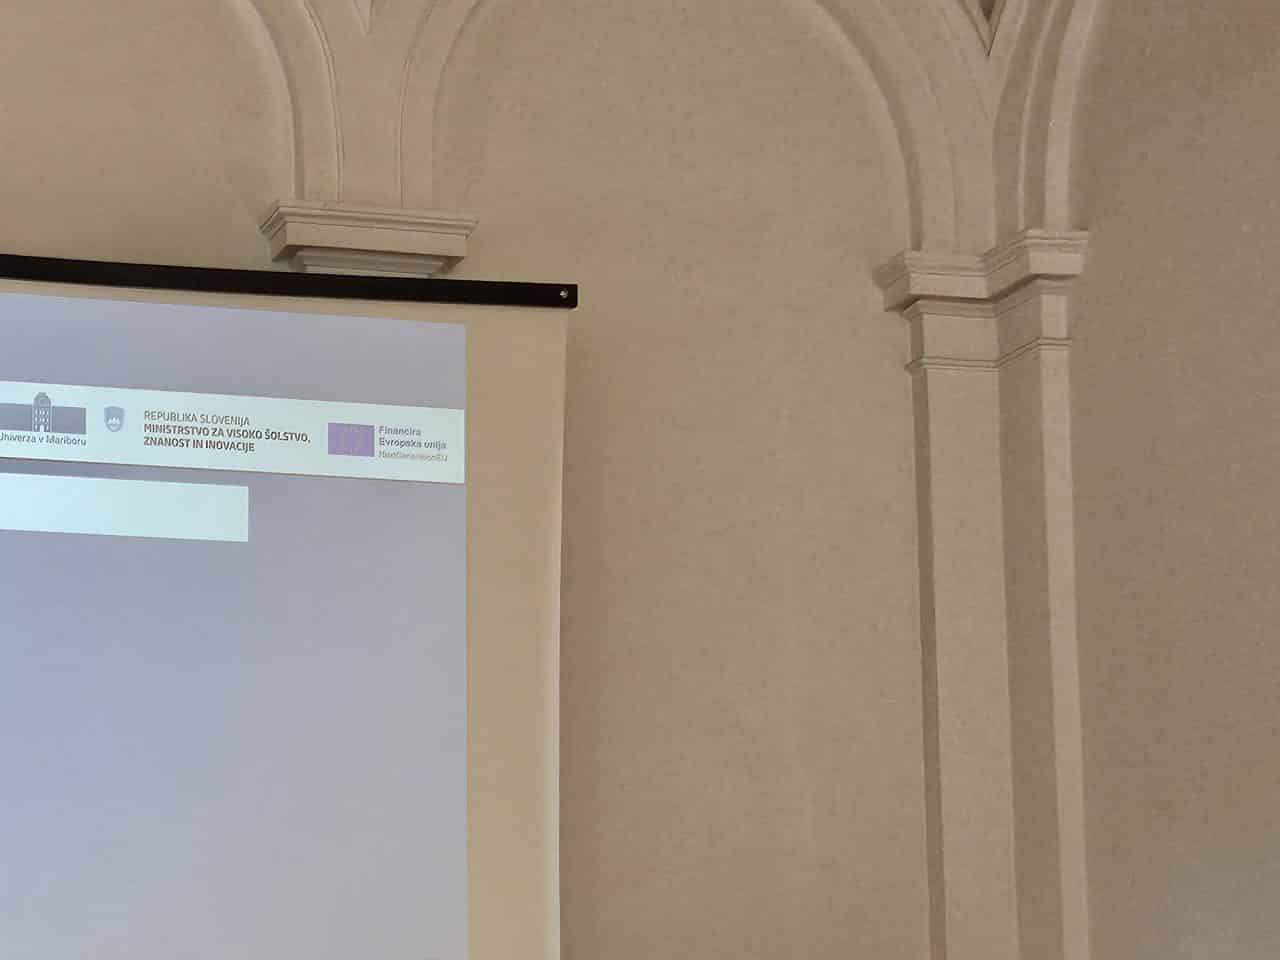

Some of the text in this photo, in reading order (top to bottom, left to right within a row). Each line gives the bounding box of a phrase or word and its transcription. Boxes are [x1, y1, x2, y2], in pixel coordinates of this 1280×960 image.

[144, 410, 250, 427] REPUBLIKA SLOVENIJA
[144, 424, 311, 443] MINISTRSTVO ZA VISOKO ŠOLSTVO,
[379, 426, 421, 436] Financira
[46, 435, 86, 446] Mariboru
[144, 437, 255, 453] ZNANOST IN INOVACIJE
[379, 437, 421, 448] Evropska
